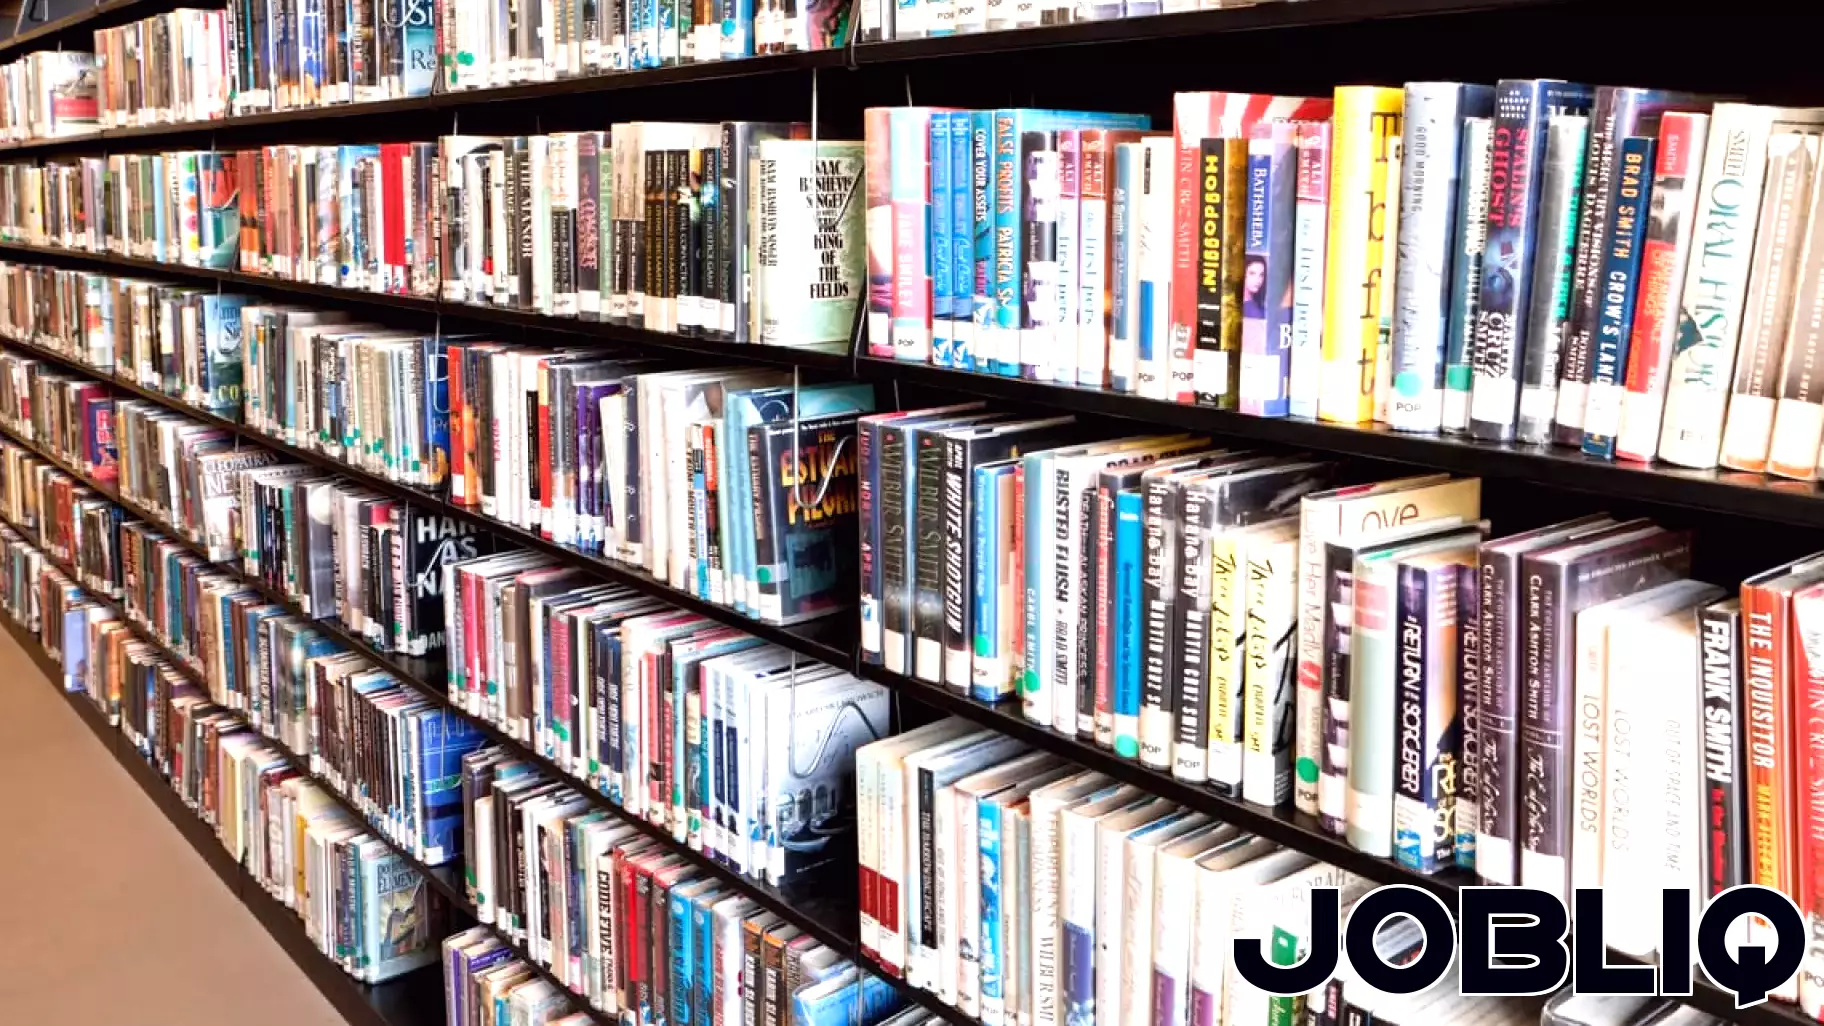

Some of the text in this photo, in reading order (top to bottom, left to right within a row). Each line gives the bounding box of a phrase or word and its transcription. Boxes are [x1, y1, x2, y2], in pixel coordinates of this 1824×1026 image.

[1413, 126, 1427, 156] GOOD
[974, 128, 988, 223] COVER YOUR ASSETS
[996, 116, 1015, 283] FALSE PROFITS PATRICIA
[1488, 127, 1511, 227] GHOST
[1508, 128, 1530, 228] STALIN'S
[1621, 152, 1644, 198] BRAD
[1250, 167, 1267, 248] BATHSHEBA
[1613, 205, 1636, 258] SMITH
[813, 233, 844, 250] KING
[821, 249, 836, 265] OF
[1177, 222, 1193, 268] SMITH
[810, 282, 849, 299] FIELDS
[818, 266, 841, 283] THE
[1602, 271, 1628, 334] CROW'S
[1485, 311, 1503, 379] CRUZ
[1575, 329, 1590, 382] DOMINI
[1396, 401, 1422, 412] POP
[882, 442, 905, 588] WILBUR SMITH
[917, 445, 941, 592] WILBUR SMITH
[1055, 469, 1070, 540] BUSTED
[1148, 482, 1168, 551] Havana
[1183, 490, 1206, 559] Havana
[945, 473, 963, 632] WHITE SHOTGUN
[1055, 544, 1070, 604] FLUSH
[1144, 557, 1166, 589] Bay
[1180, 564, 1205, 598] Bay
[1305, 561, 1321, 597] Her
[1301, 604, 1320, 658] Madly
[1527, 574, 1542, 719] CLARK ASHTON SMITH
[1700, 619, 1731, 699] FRANK
[1750, 612, 1773, 649] THE
[1482, 665, 1494, 705] SMITH
[1748, 655, 1775, 769] INQUISITOR
[1176, 758, 1201, 770] POP
[1580, 694, 1600, 834] LOST WORLDS
[1704, 705, 1732, 784] SMITH
[597, 869, 611, 912] CODE
[599, 916, 612, 955] FIVE
